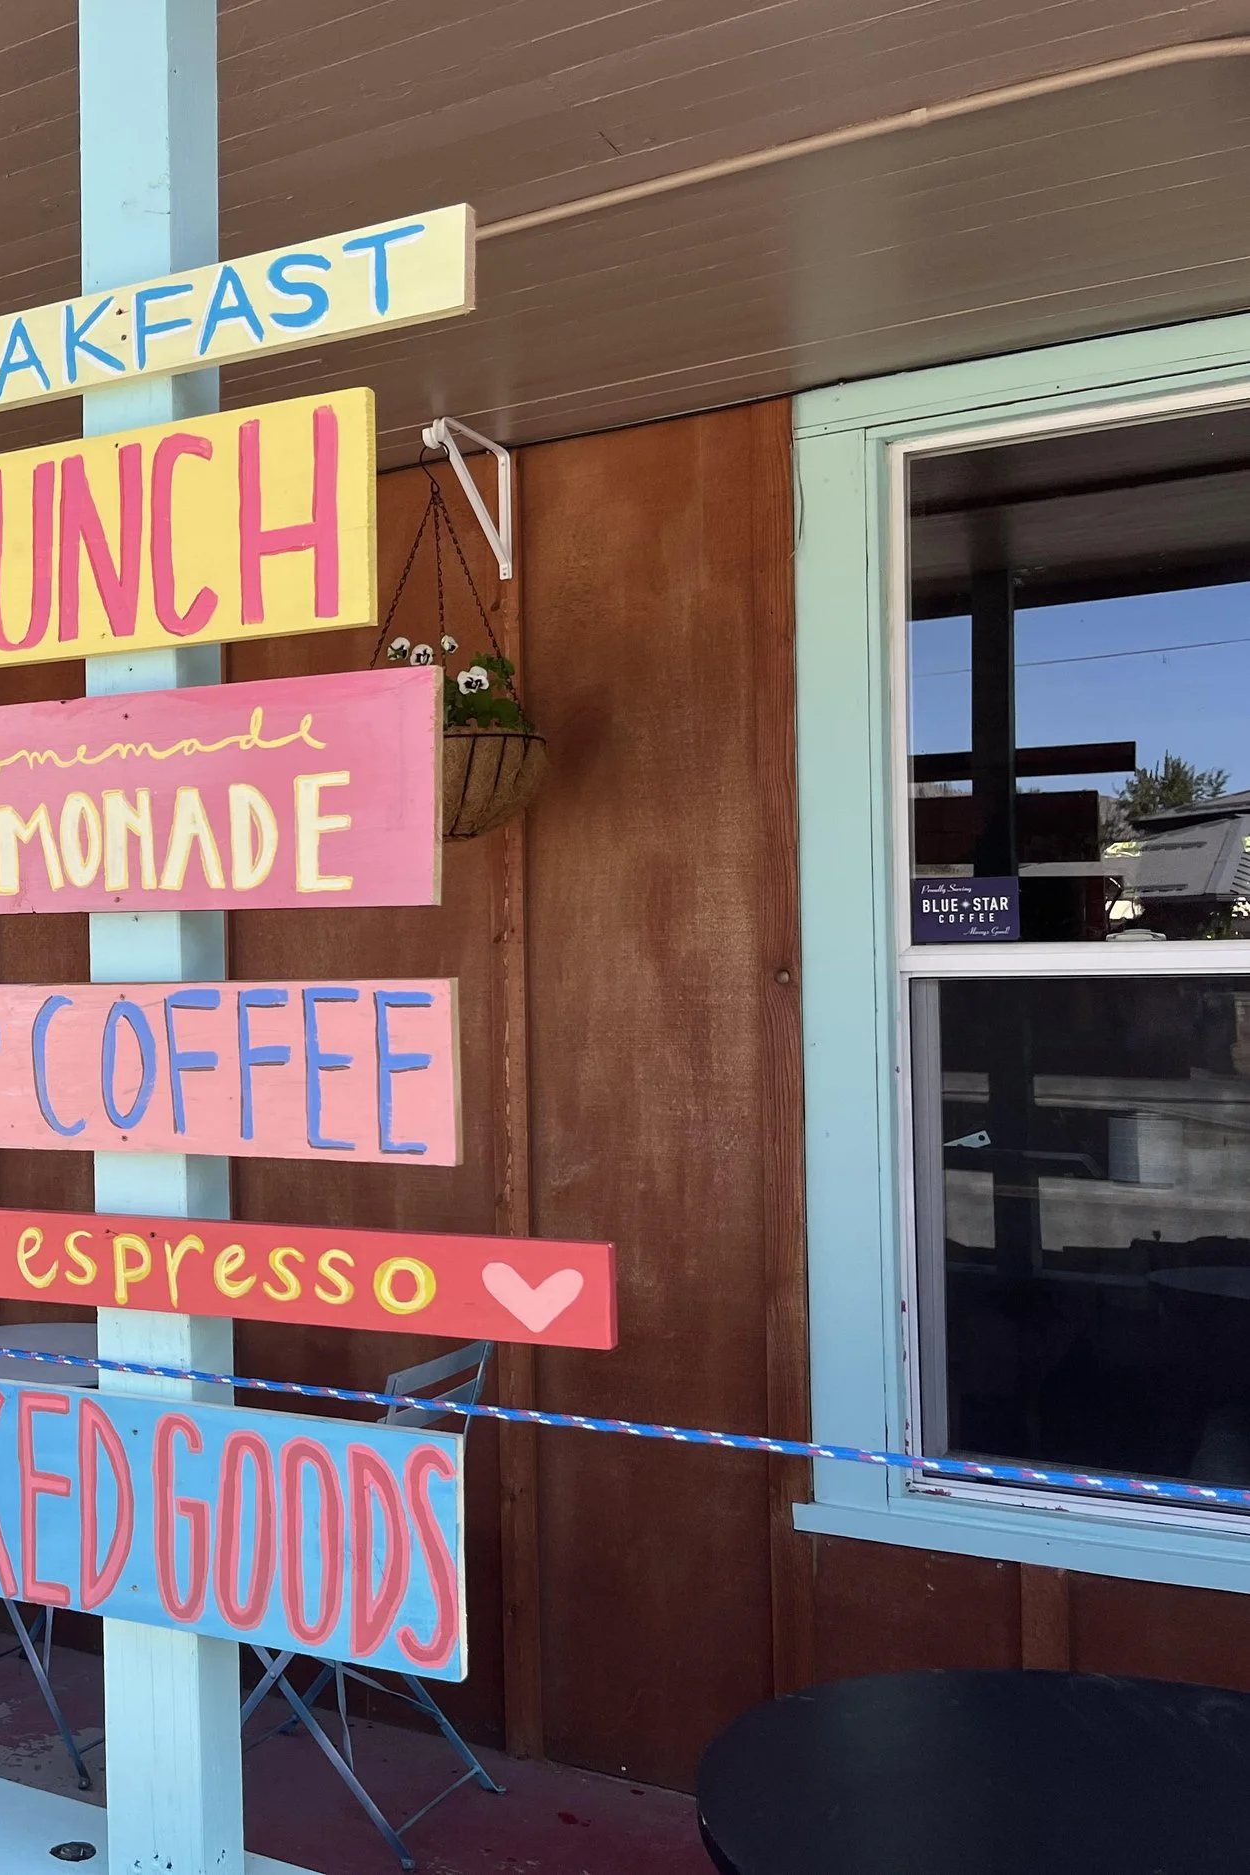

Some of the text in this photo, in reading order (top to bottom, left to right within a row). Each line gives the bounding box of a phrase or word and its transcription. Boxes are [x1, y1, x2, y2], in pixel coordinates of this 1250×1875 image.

[922, 896, 1009, 913] BLUE STAR
[938, 912, 995, 924] COFFEE
[31, 987, 435, 1154] COFFEE
[16, 1226, 436, 1315] espresso
[153, 1412, 458, 1669] GOODS
